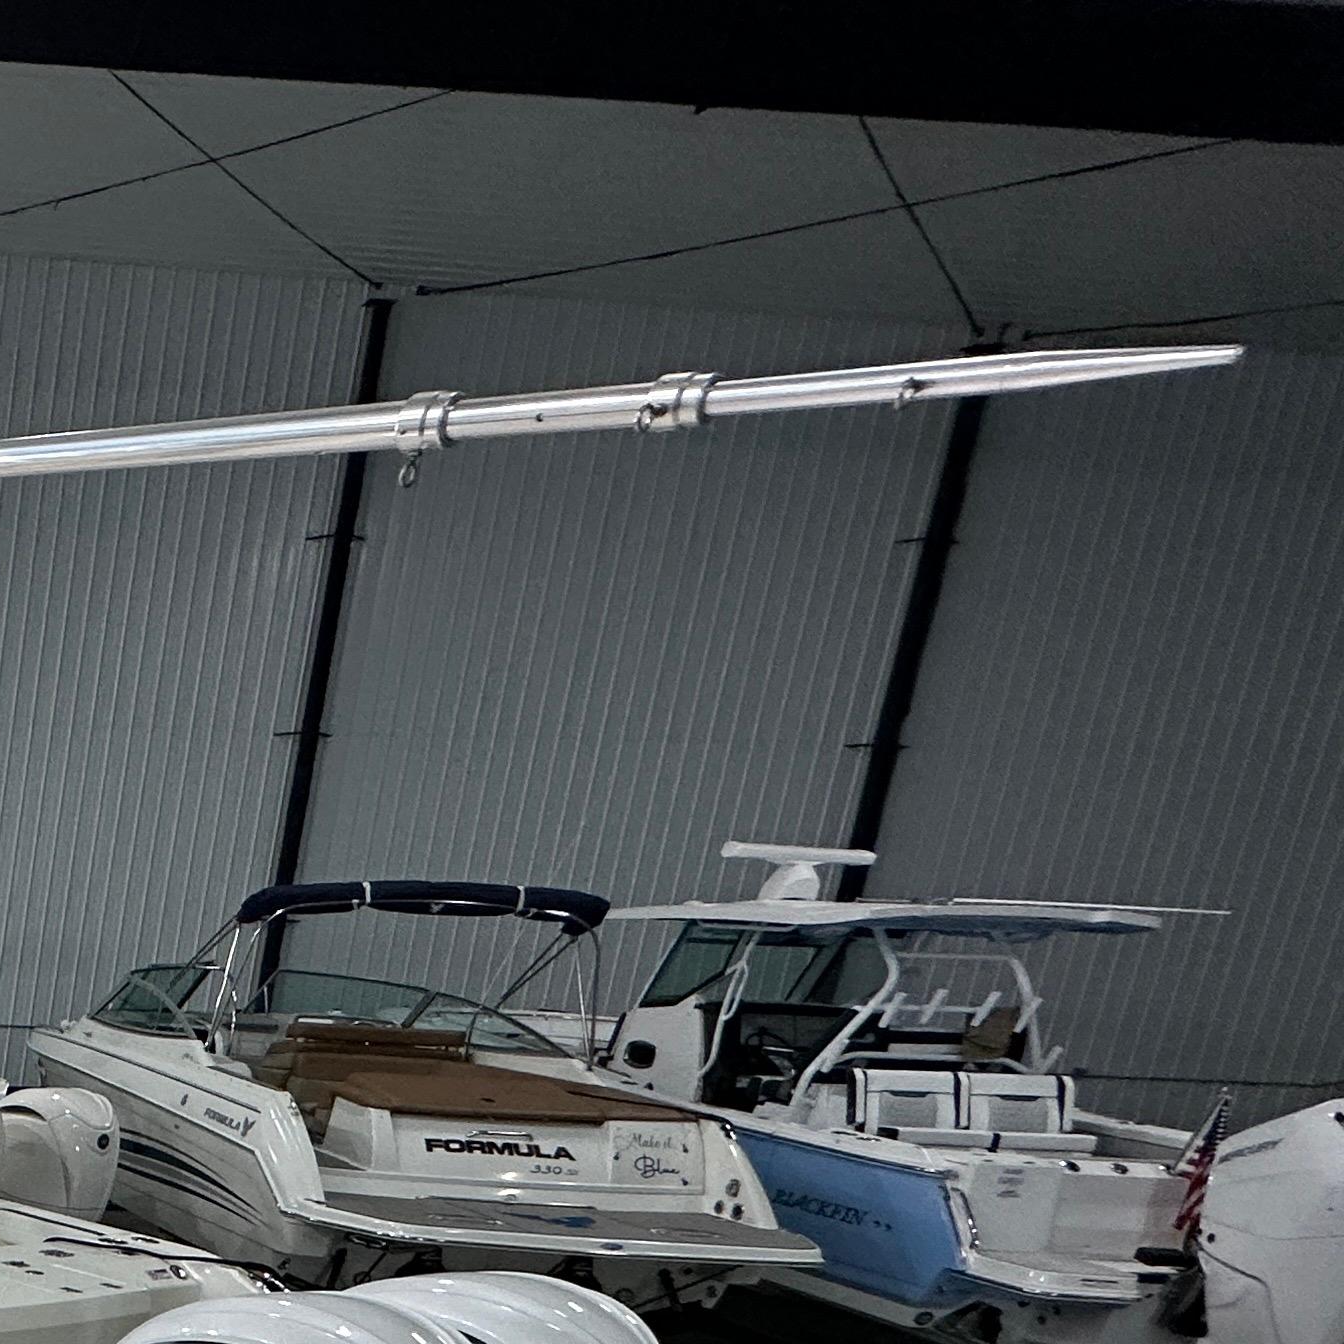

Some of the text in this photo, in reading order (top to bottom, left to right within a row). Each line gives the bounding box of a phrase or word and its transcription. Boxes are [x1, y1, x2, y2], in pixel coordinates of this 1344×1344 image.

[424, 1138, 576, 1162] FORMULA
[529, 1164, 562, 1175] 330
[634, 1153, 680, 1179] Blue
